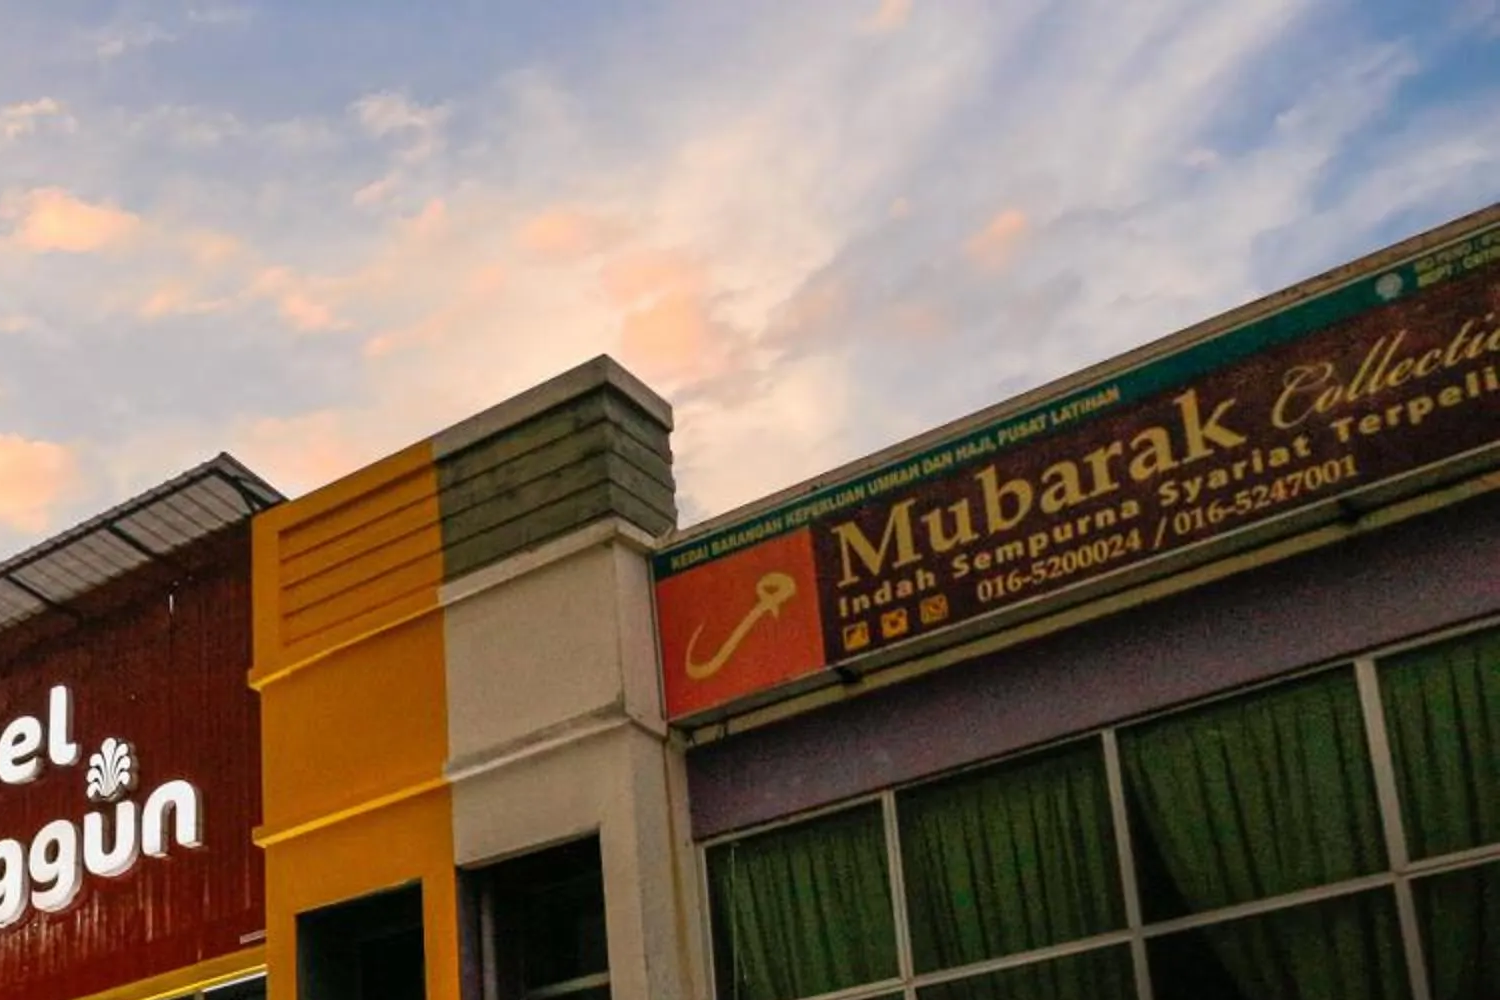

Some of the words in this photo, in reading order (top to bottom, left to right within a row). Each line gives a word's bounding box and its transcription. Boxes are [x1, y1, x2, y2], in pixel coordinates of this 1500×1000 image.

[671, 544, 709, 570] KEDAI
[710, 519, 784, 556] BARANGAN
[785, 484, 866, 526] KEPERLUAN
[867, 460, 921, 494] UMRAH
[922, 451, 952, 475] DAN
[998, 413, 1048, 444] PUSAT
[1052, 384, 1121, 426] LATIHAN
[831, 387, 1248, 589] Mubarak
[837, 567, 936, 617] Indah
[951, 498, 1141, 580] Sempurna
[1157, 434, 1312, 507] Syariat
[976, 528, 1143, 602] 016-5200024
[1173, 453, 1359, 536] 016-5247001
